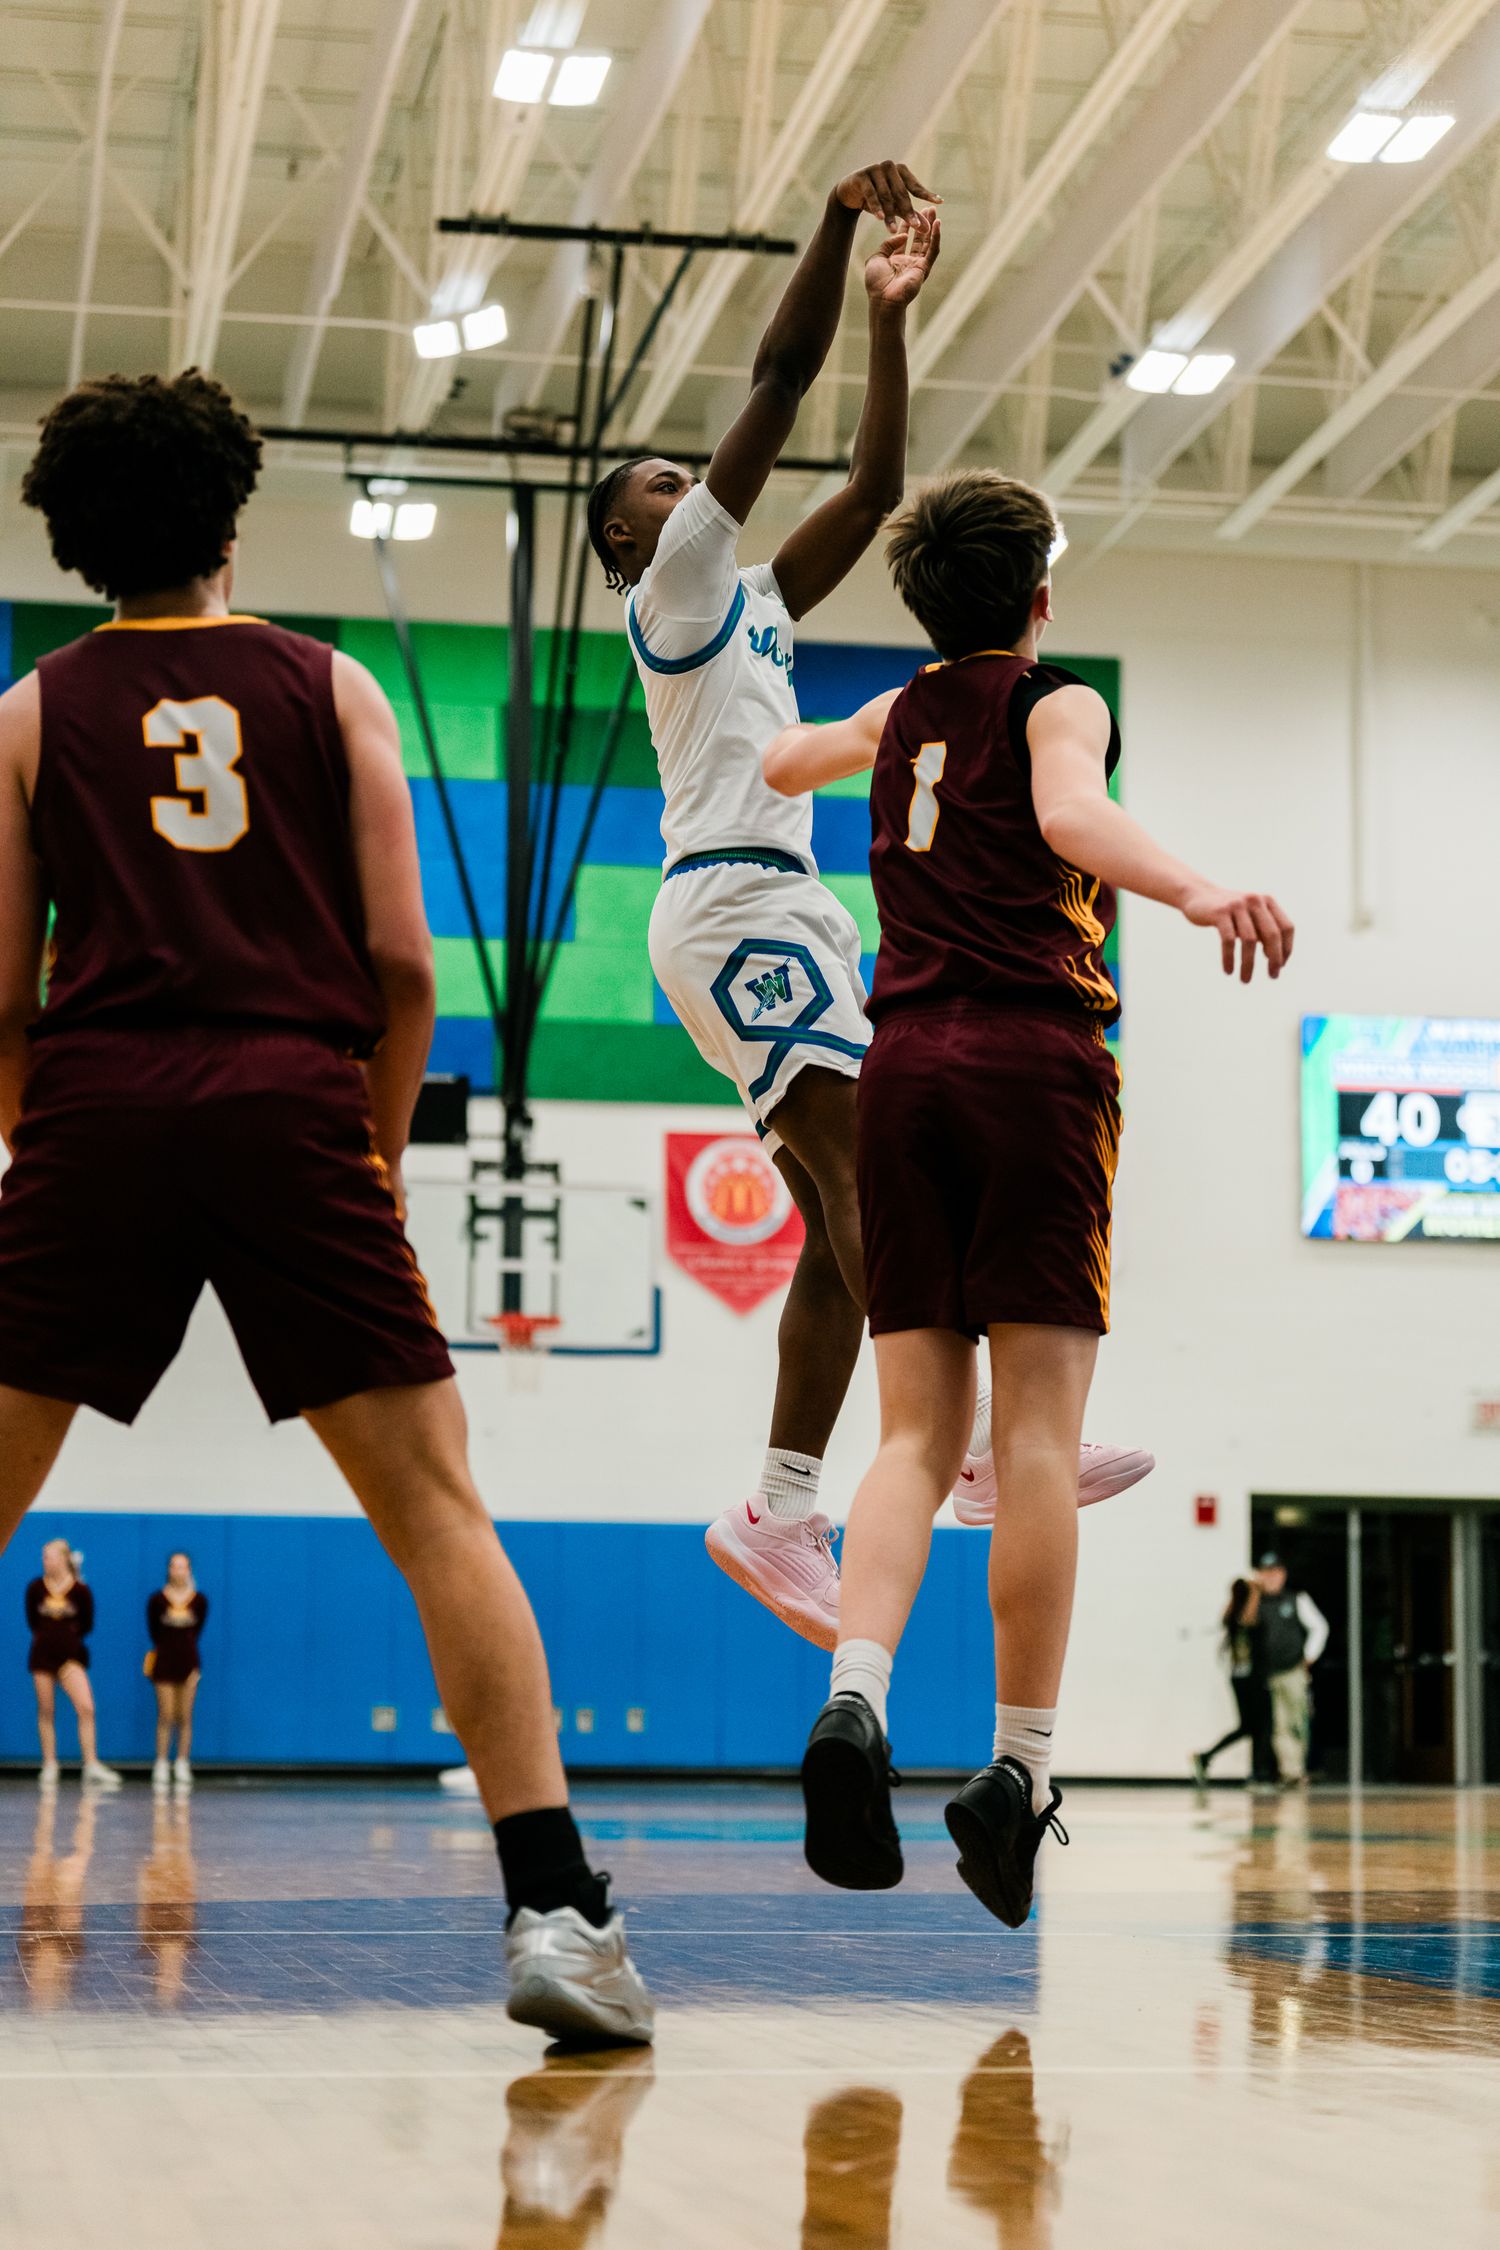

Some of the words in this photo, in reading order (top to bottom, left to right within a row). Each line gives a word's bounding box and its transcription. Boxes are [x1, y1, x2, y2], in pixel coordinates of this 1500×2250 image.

[142, 695, 249, 852] 3
[904, 740, 947, 852] 1
[744, 964, 793, 1011] W
[1360, 1090, 1441, 1147] 40
